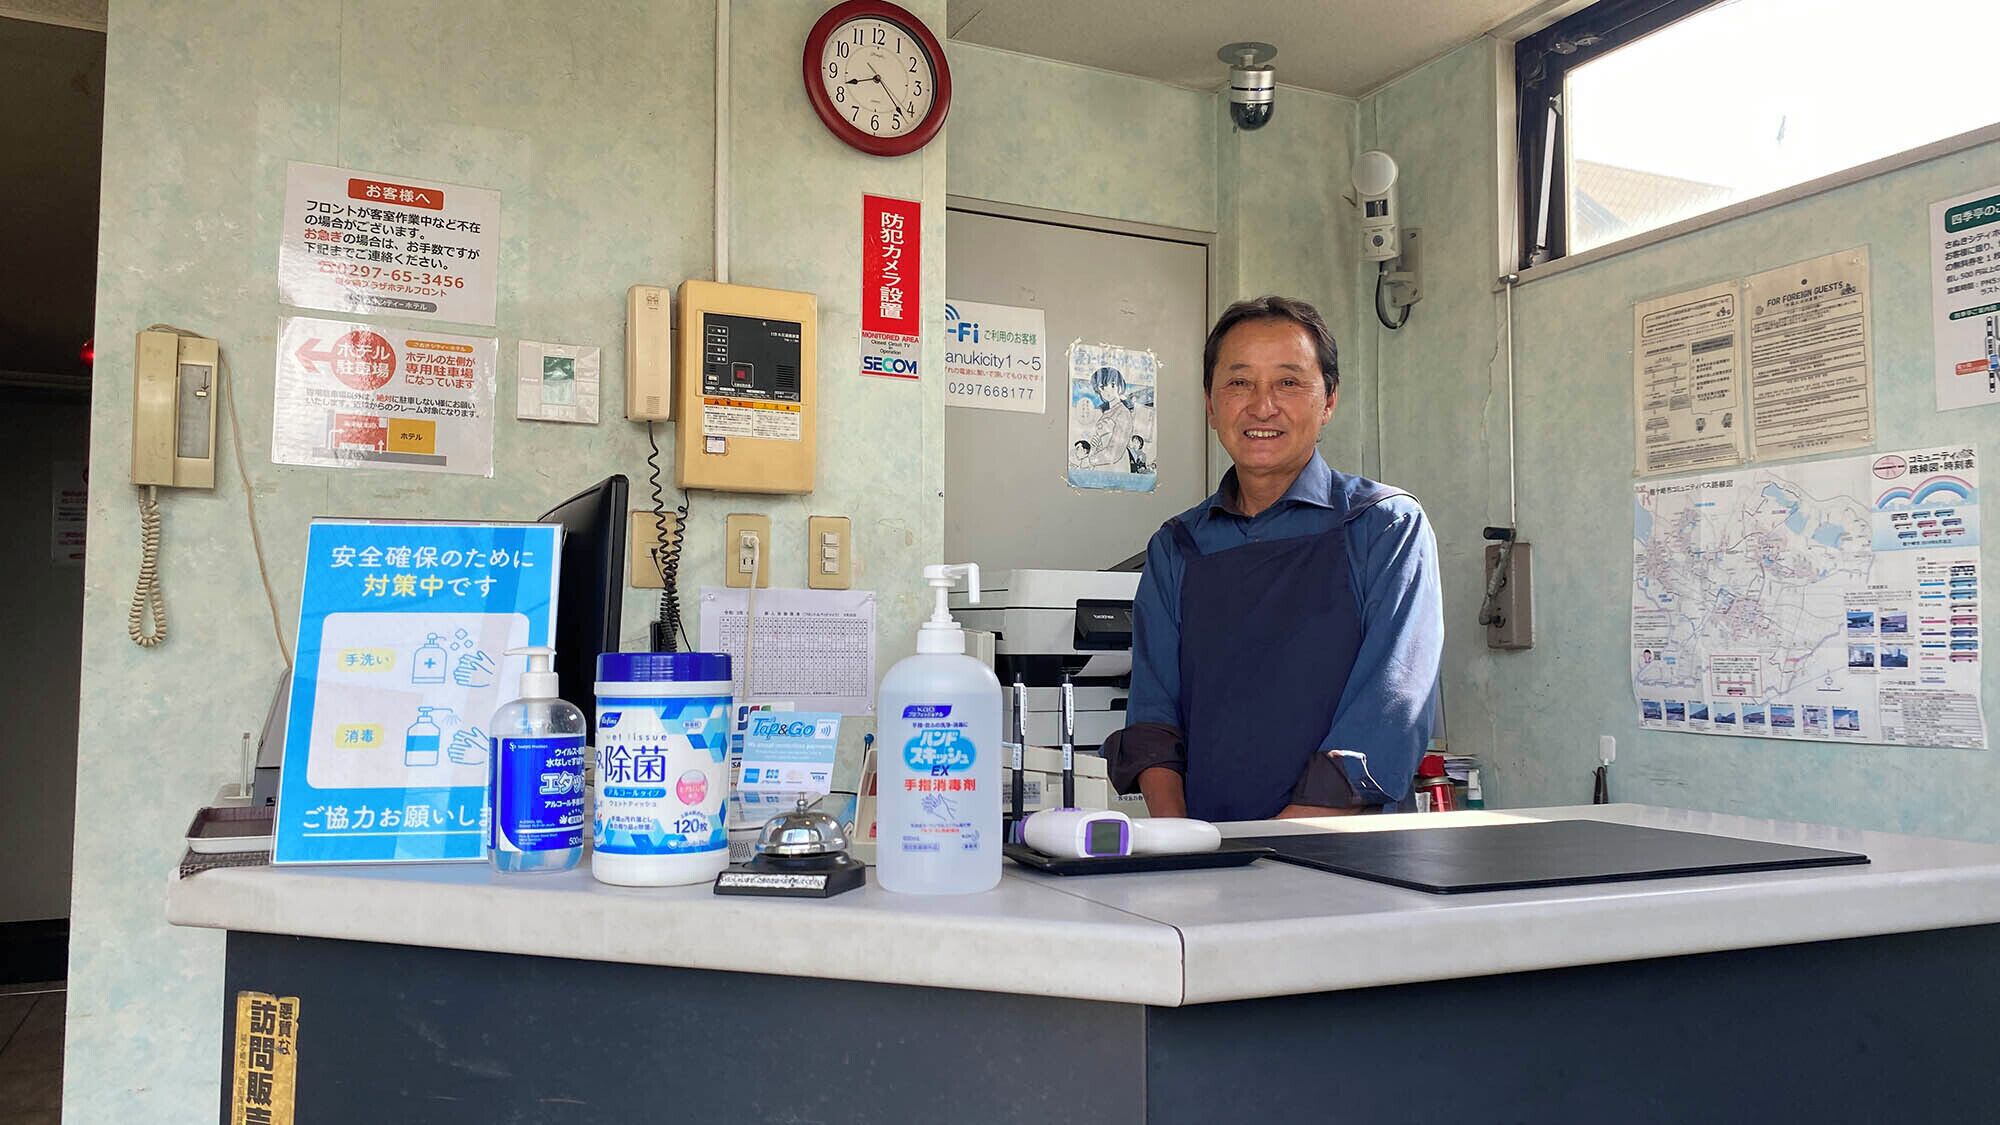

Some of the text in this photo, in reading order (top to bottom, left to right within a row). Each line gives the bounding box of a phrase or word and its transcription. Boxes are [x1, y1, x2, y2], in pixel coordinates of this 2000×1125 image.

[853, 28, 864, 45] 11
[872, 28, 886, 45] 12
[836, 40, 849, 58] 10
[896, 38, 900, 53] 1
[829, 62, 838, 78] 9
[909, 57, 917, 72] 2
[836, 86, 845, 102] 8
[913, 80, 922, 96] 3
[852, 106, 859, 122] 7
[907, 102, 915, 118] 4
[870, 114, 879, 130] 6
[892, 114, 900, 129] 5
[366, 184, 430, 204] お客様へ
[306, 200, 480, 234] フロントが客室作業中など不在
[304, 214, 425, 240] の場合がございます。
[304, 228, 480, 260] お急ぎの場合は、お手数ですが
[304, 242, 449, 270] 下記までご連絡ください。
[880, 212, 904, 320] 防犯カメラ設置
[1767, 280, 1843, 308] FOR FOREIGN GUESTS
[862, 332, 899, 341] MONITORED
[984, 330, 1036, 345] ご利用のお客様
[337, 342, 391, 360] ホテル
[406, 352, 476, 367] ホテルの左側が
[864, 356, 917, 374] SECOM
[336, 360, 390, 379] 駐車場
[406, 364, 474, 379] 専用駐車場
[406, 375, 474, 389] になっています
[949, 382, 1033, 399] 0297668177
[400, 433, 422, 441] ホテル
[331, 545, 534, 569] 安全確保のために
[362, 574, 497, 598] 対策中です
[345, 654, 389, 666] 手洗い
[344, 729, 374, 744] 消毒
[753, 717, 816, 740] Tap&Go
[920, 732, 959, 746] ハンド
[604, 745, 668, 783] 除菌
[910, 747, 969, 765] スキッシュ
[931, 765, 950, 776] EX
[904, 778, 976, 792] 手指消毒剤
[608, 789, 662, 798] アルコールタイプ
